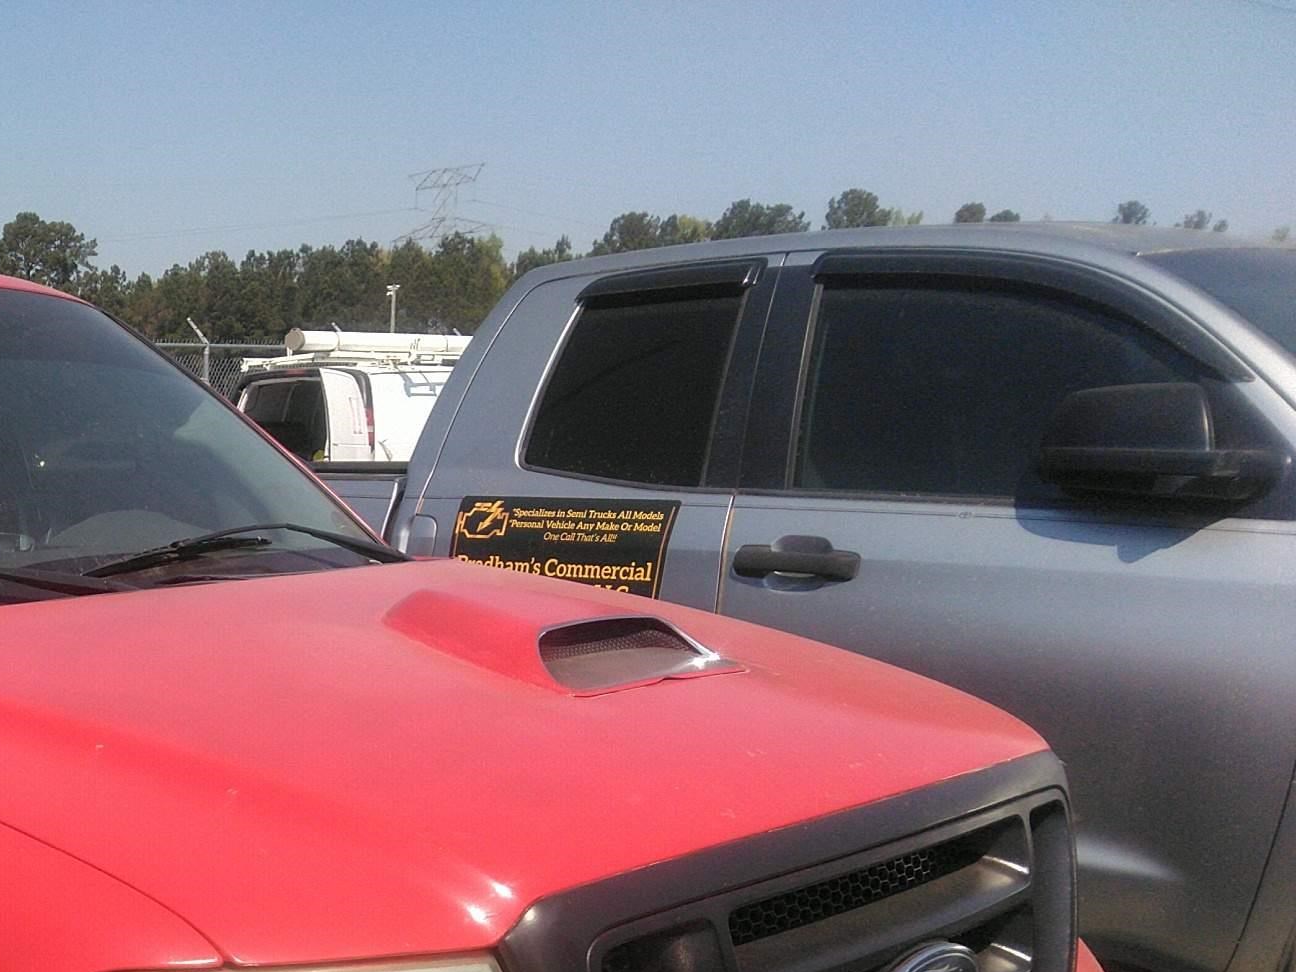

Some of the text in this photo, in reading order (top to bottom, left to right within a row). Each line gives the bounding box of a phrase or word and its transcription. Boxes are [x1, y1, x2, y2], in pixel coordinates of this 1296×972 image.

[557, 509, 566, 518] in
[566, 509, 587, 518] Semi
[588, 510, 617, 519] Trucks
[616, 510, 633, 519] All
[632, 511, 664, 520] Models
[546, 520, 576, 530] Vehicle
[575, 521, 595, 531] Any
[595, 522, 620, 531] Make
[620, 522, 633, 531] Or
[633, 522, 662, 532] Model
[544, 531, 560, 541] One
[560, 532, 577, 541] Call
[576, 533, 601, 542] That's
[457, 554, 653, 581] dham's Commercial
